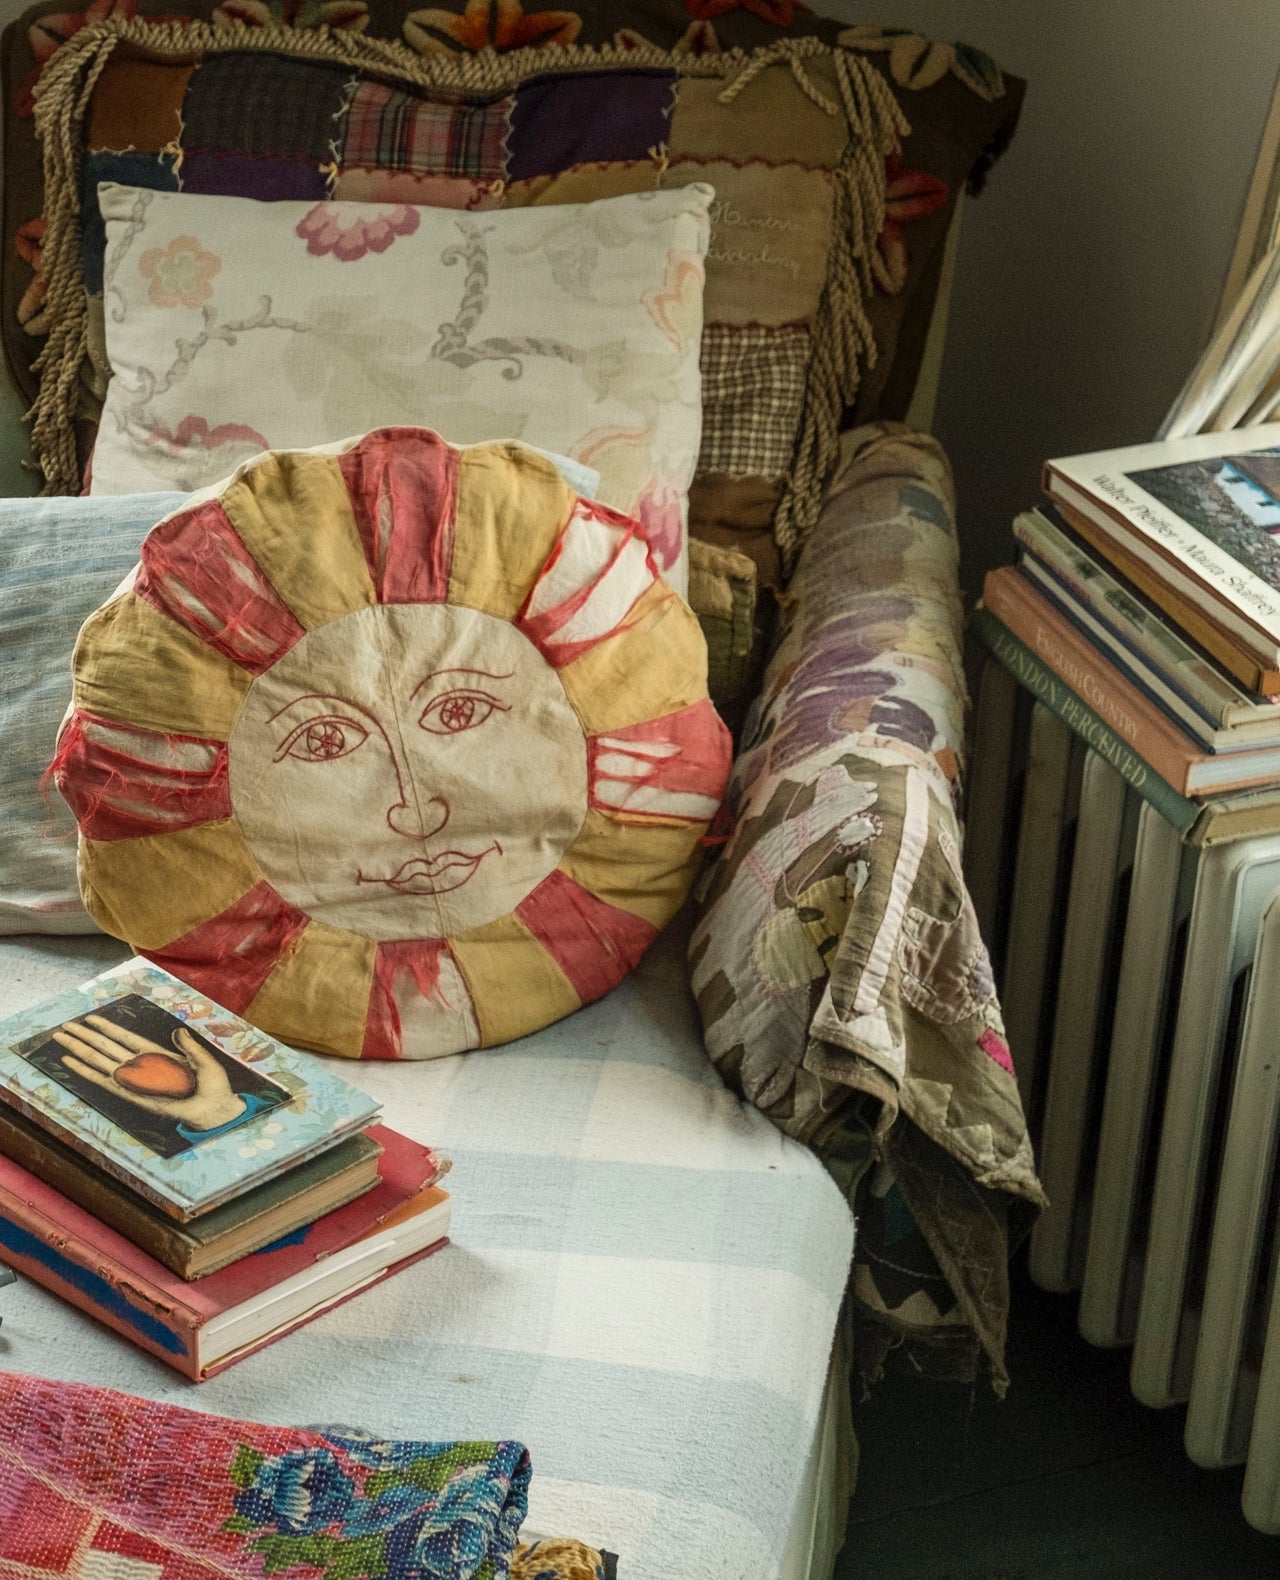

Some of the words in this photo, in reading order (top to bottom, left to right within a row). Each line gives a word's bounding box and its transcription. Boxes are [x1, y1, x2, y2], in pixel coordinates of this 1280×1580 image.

[1093, 474, 1135, 510] Walter
[1182, 543, 1226, 578] Maura
[994, 632, 1058, 704] LONDON
[1060, 696, 1148, 788] PERCEIVED
